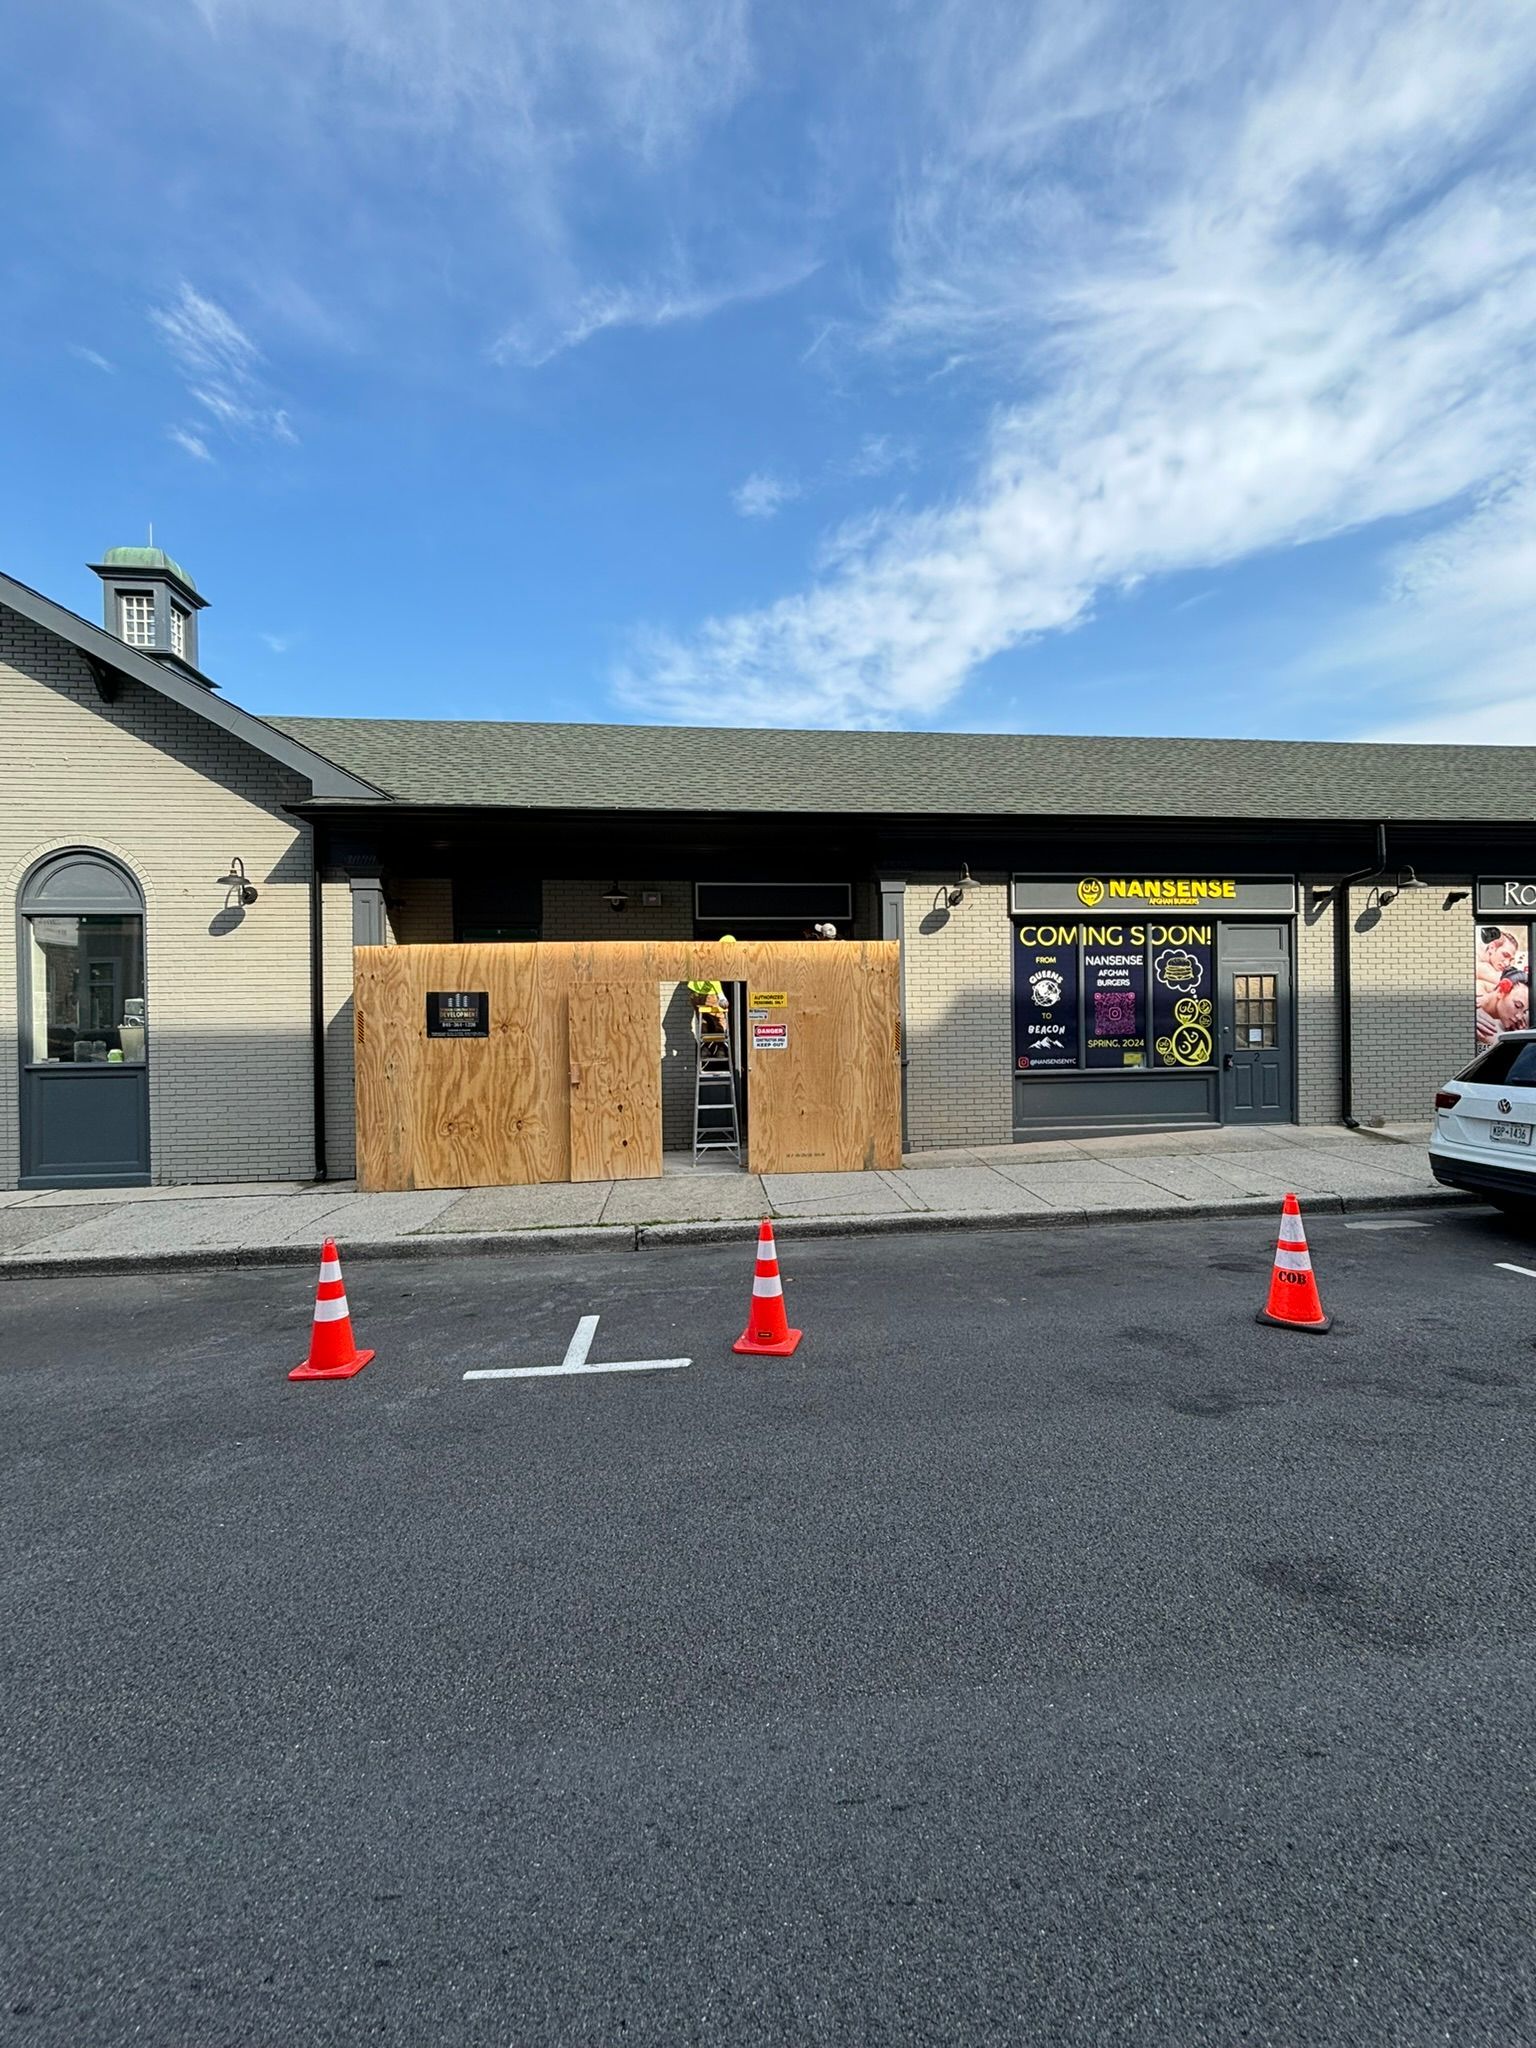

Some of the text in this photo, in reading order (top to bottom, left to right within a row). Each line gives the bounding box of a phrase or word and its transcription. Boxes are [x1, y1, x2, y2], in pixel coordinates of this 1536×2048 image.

[1109, 879, 1236, 899] NANSENSE
[1148, 898, 1199, 906] AFGHAN BURGERS
[1019, 925, 1212, 946] COMING SOON!
[1035, 956, 1057, 964] FROM
[1085, 955, 1144, 966] NANSENSE
[1098, 969, 1129, 977] AFGHAN
[1029, 970, 1064, 985] QUEENS
[1097, 979, 1130, 987] BURGERS
[1041, 1012, 1053, 1020] TO
[1028, 1025, 1066, 1035] BEACON
[1122, 1039, 1145, 1048] 2024
[1254, 1053, 1260, 1061] 2
[1030, 1058, 1077, 1066] @NANSENSENYC
[1278, 1271, 1307, 1285] COB
